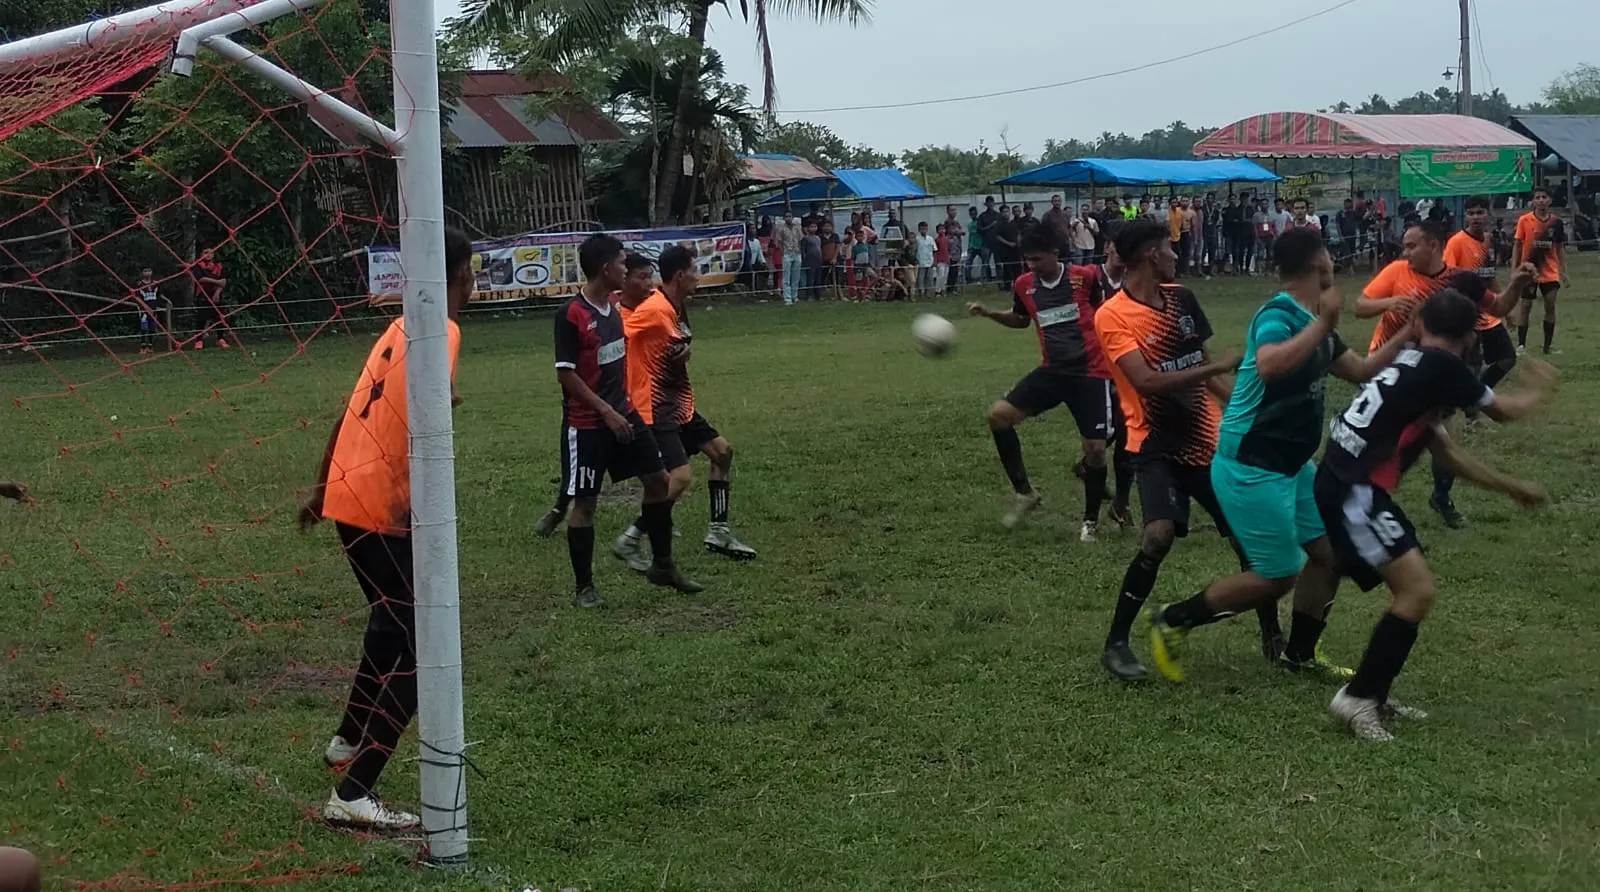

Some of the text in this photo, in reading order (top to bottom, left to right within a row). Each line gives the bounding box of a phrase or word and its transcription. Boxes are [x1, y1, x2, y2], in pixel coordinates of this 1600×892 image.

[479, 285, 585, 301] BINTANG JAY
[579, 466, 596, 489] 14
